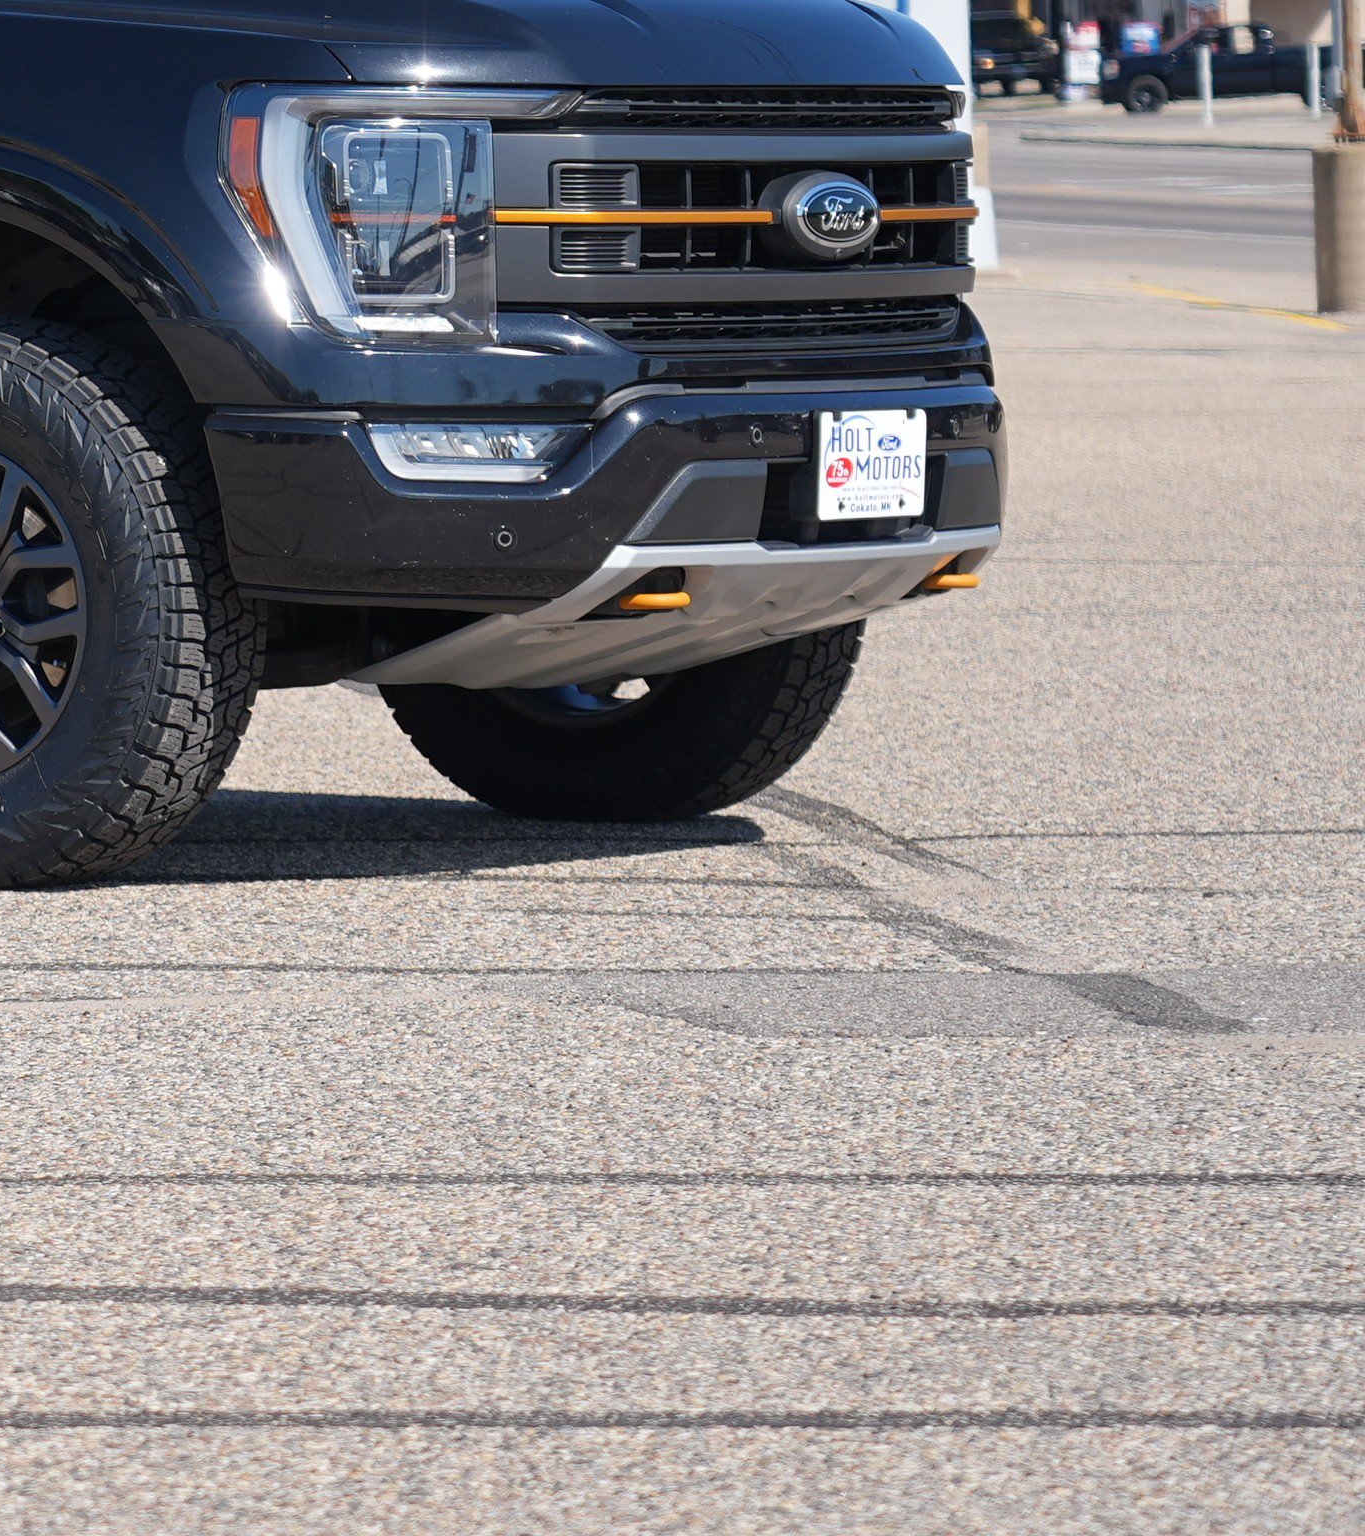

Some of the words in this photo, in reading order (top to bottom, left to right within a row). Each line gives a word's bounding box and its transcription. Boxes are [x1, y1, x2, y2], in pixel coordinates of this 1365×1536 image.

[821, 195, 865, 232] Ford
[831, 426, 874, 453] HOLT
[855, 455, 922, 481] MOTORS
[881, 502, 892, 511] MN
